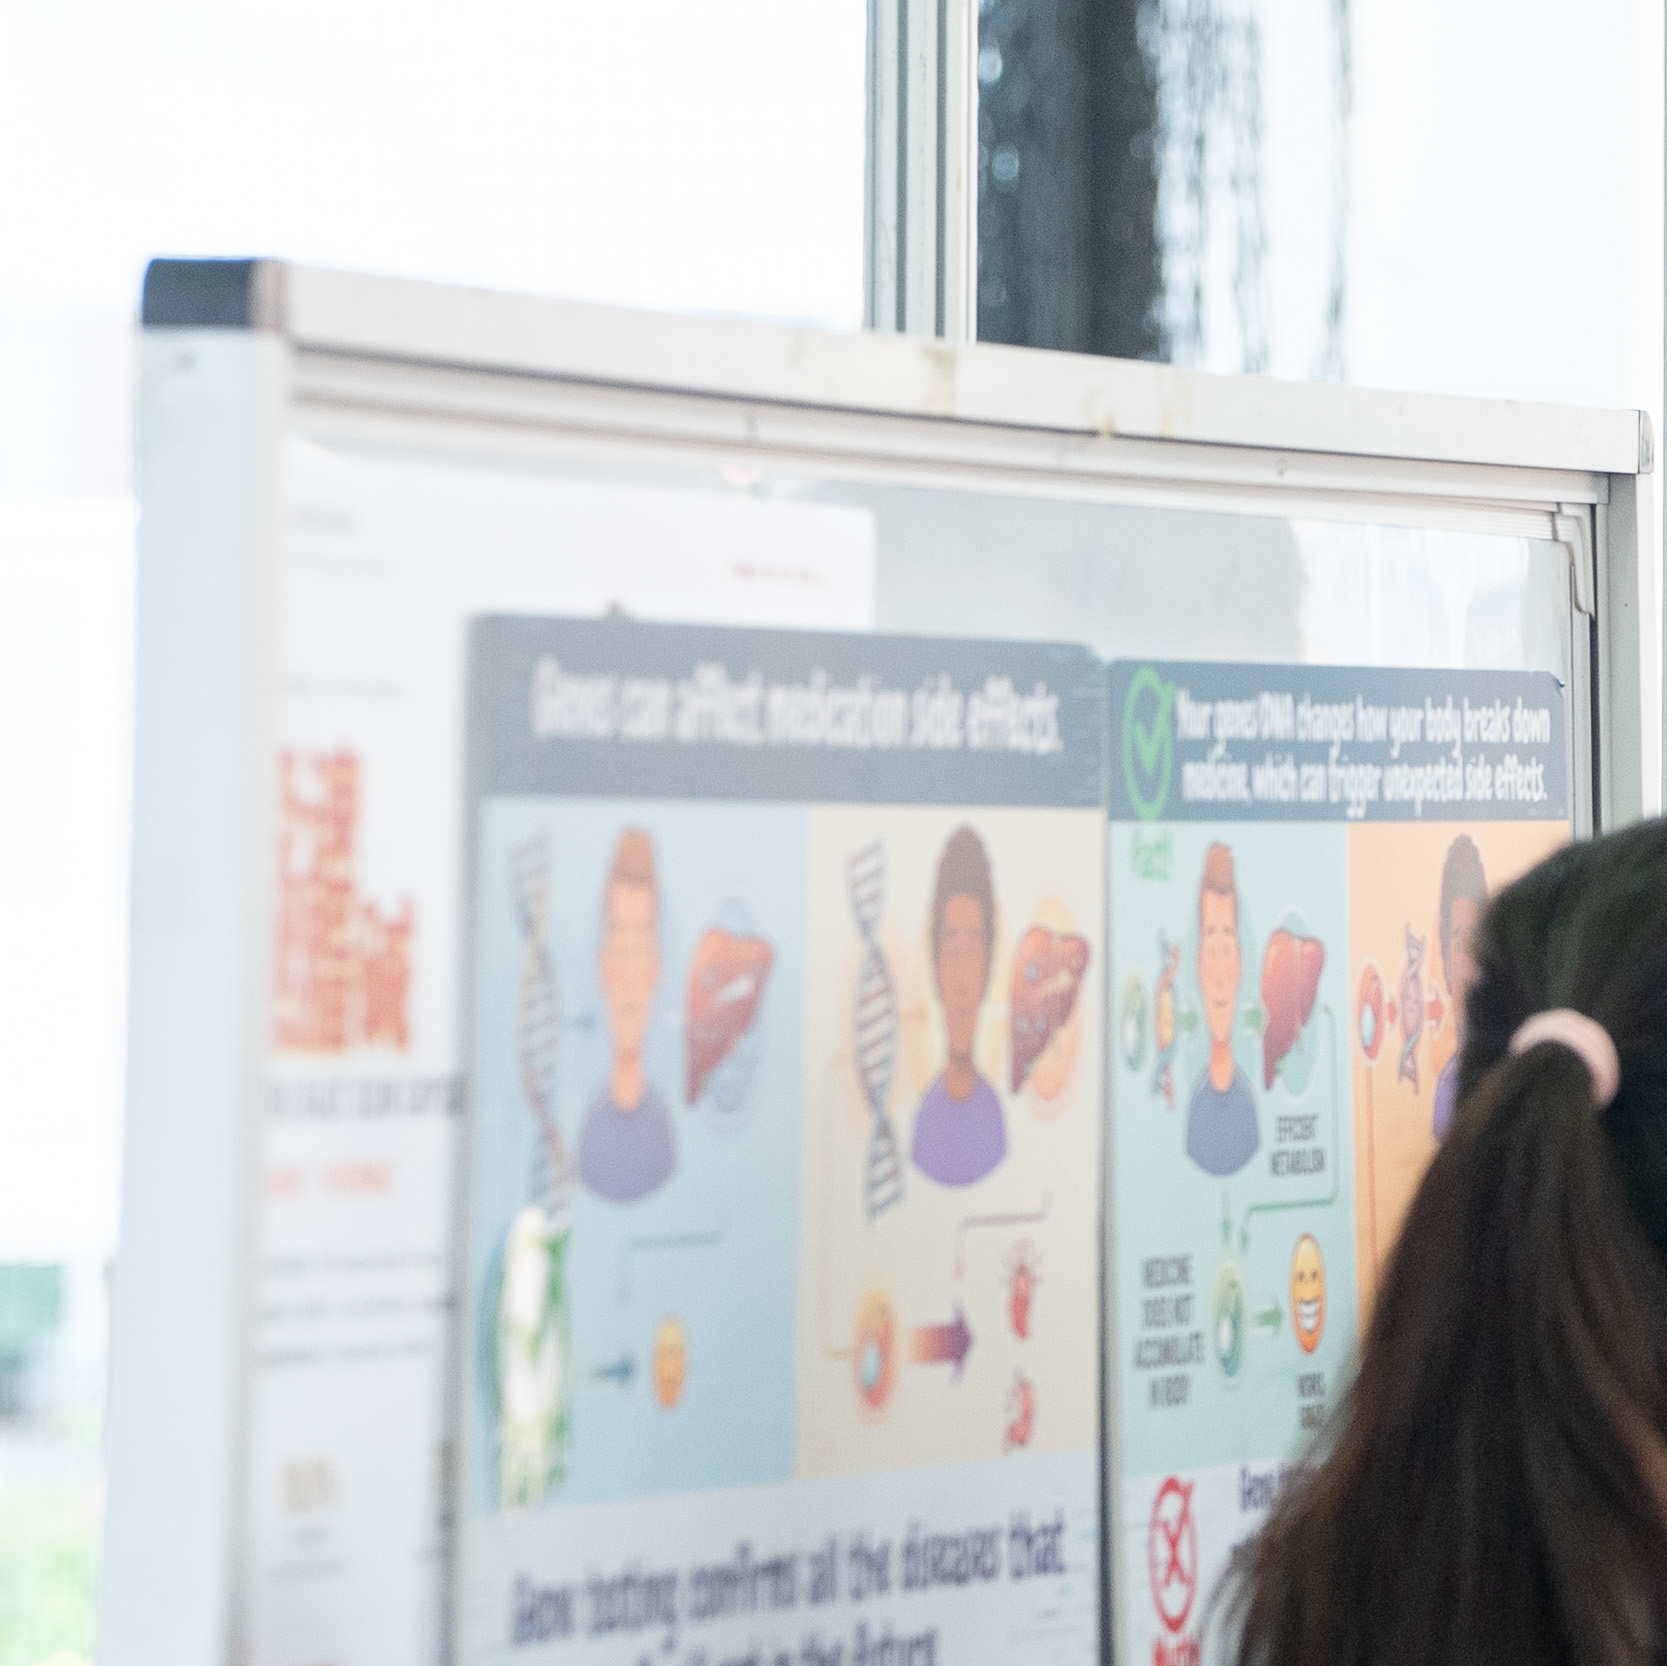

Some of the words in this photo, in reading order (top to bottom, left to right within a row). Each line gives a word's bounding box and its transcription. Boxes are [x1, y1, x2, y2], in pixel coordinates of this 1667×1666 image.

[911, 671, 963, 748] side
[1176, 688, 1211, 740] Your
[1297, 694, 1354, 760] changes
[1355, 694, 1387, 741] how
[1390, 702, 1424, 758] your
[1425, 695, 1461, 758] body
[1463, 695, 1509, 743] breaks
[1512, 696, 1551, 744] down
[1252, 752, 1298, 802] which
[1300, 760, 1327, 802] can
[1328, 752, 1382, 819] trigger
[1384, 752, 1463, 818] unexpected
[1464, 754, 1492, 802] side
[1494, 753, 1548, 803] effects.
[849, 1529, 891, 1601] the
[1008, 1506, 1067, 1581] that
